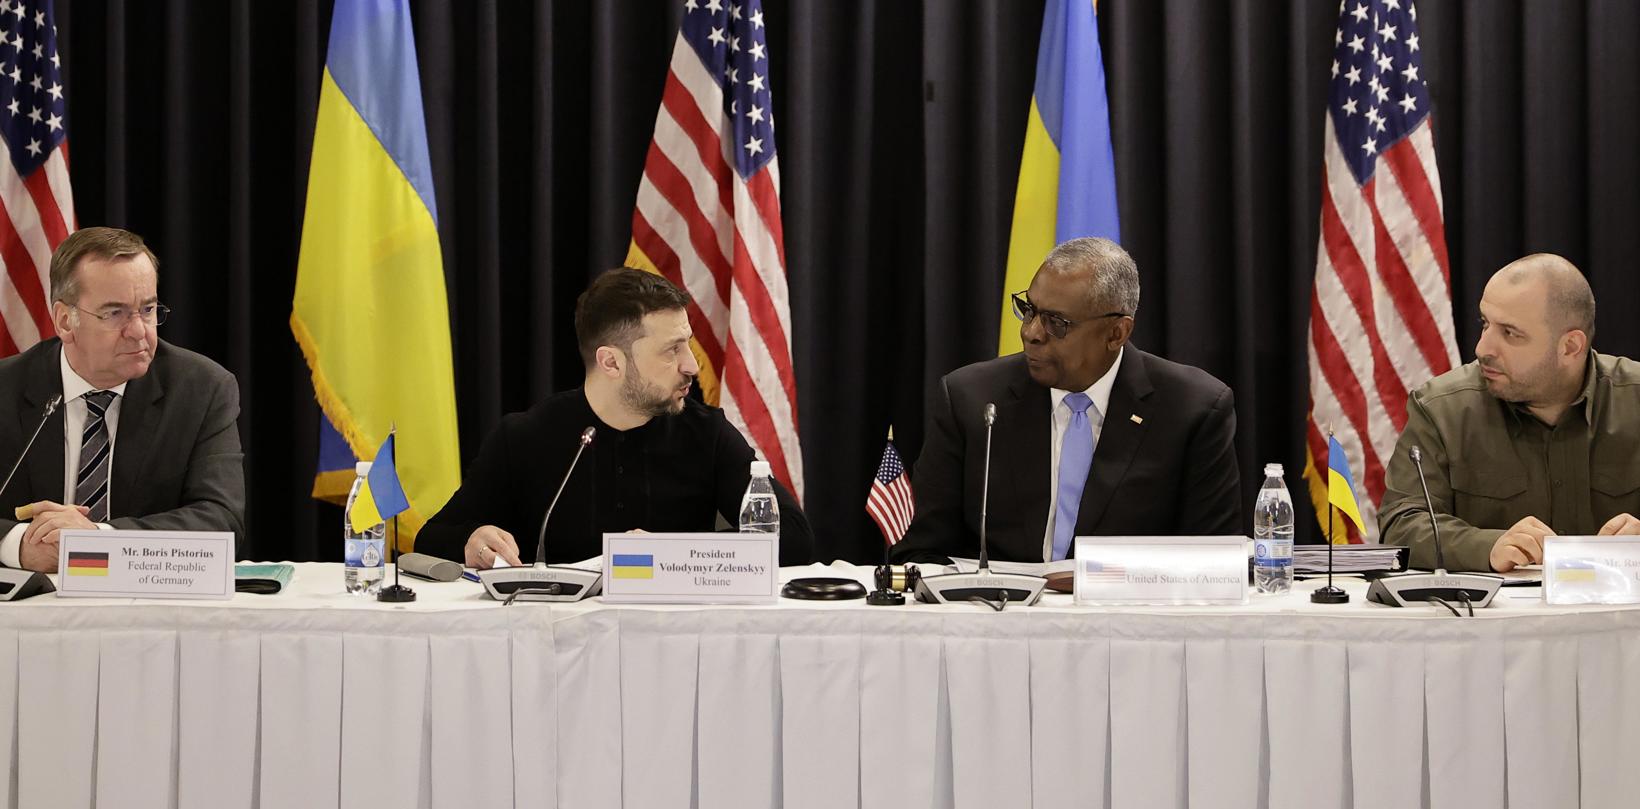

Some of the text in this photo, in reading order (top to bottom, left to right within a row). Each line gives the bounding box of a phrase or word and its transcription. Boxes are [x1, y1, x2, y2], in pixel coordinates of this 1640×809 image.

[121, 547, 214, 558] Mr. Boris Pistorius
[690, 549, 735, 559] President
[128, 560, 206, 573] Federal Republic
[659, 563, 765, 574] Volodymyr Zelenskyy
[138, 574, 194, 587] of Germany
[530, 572, 557, 580] BOSCH
[694, 576, 731, 586] Ukraine
[1126, 574, 1241, 584] United States of America
